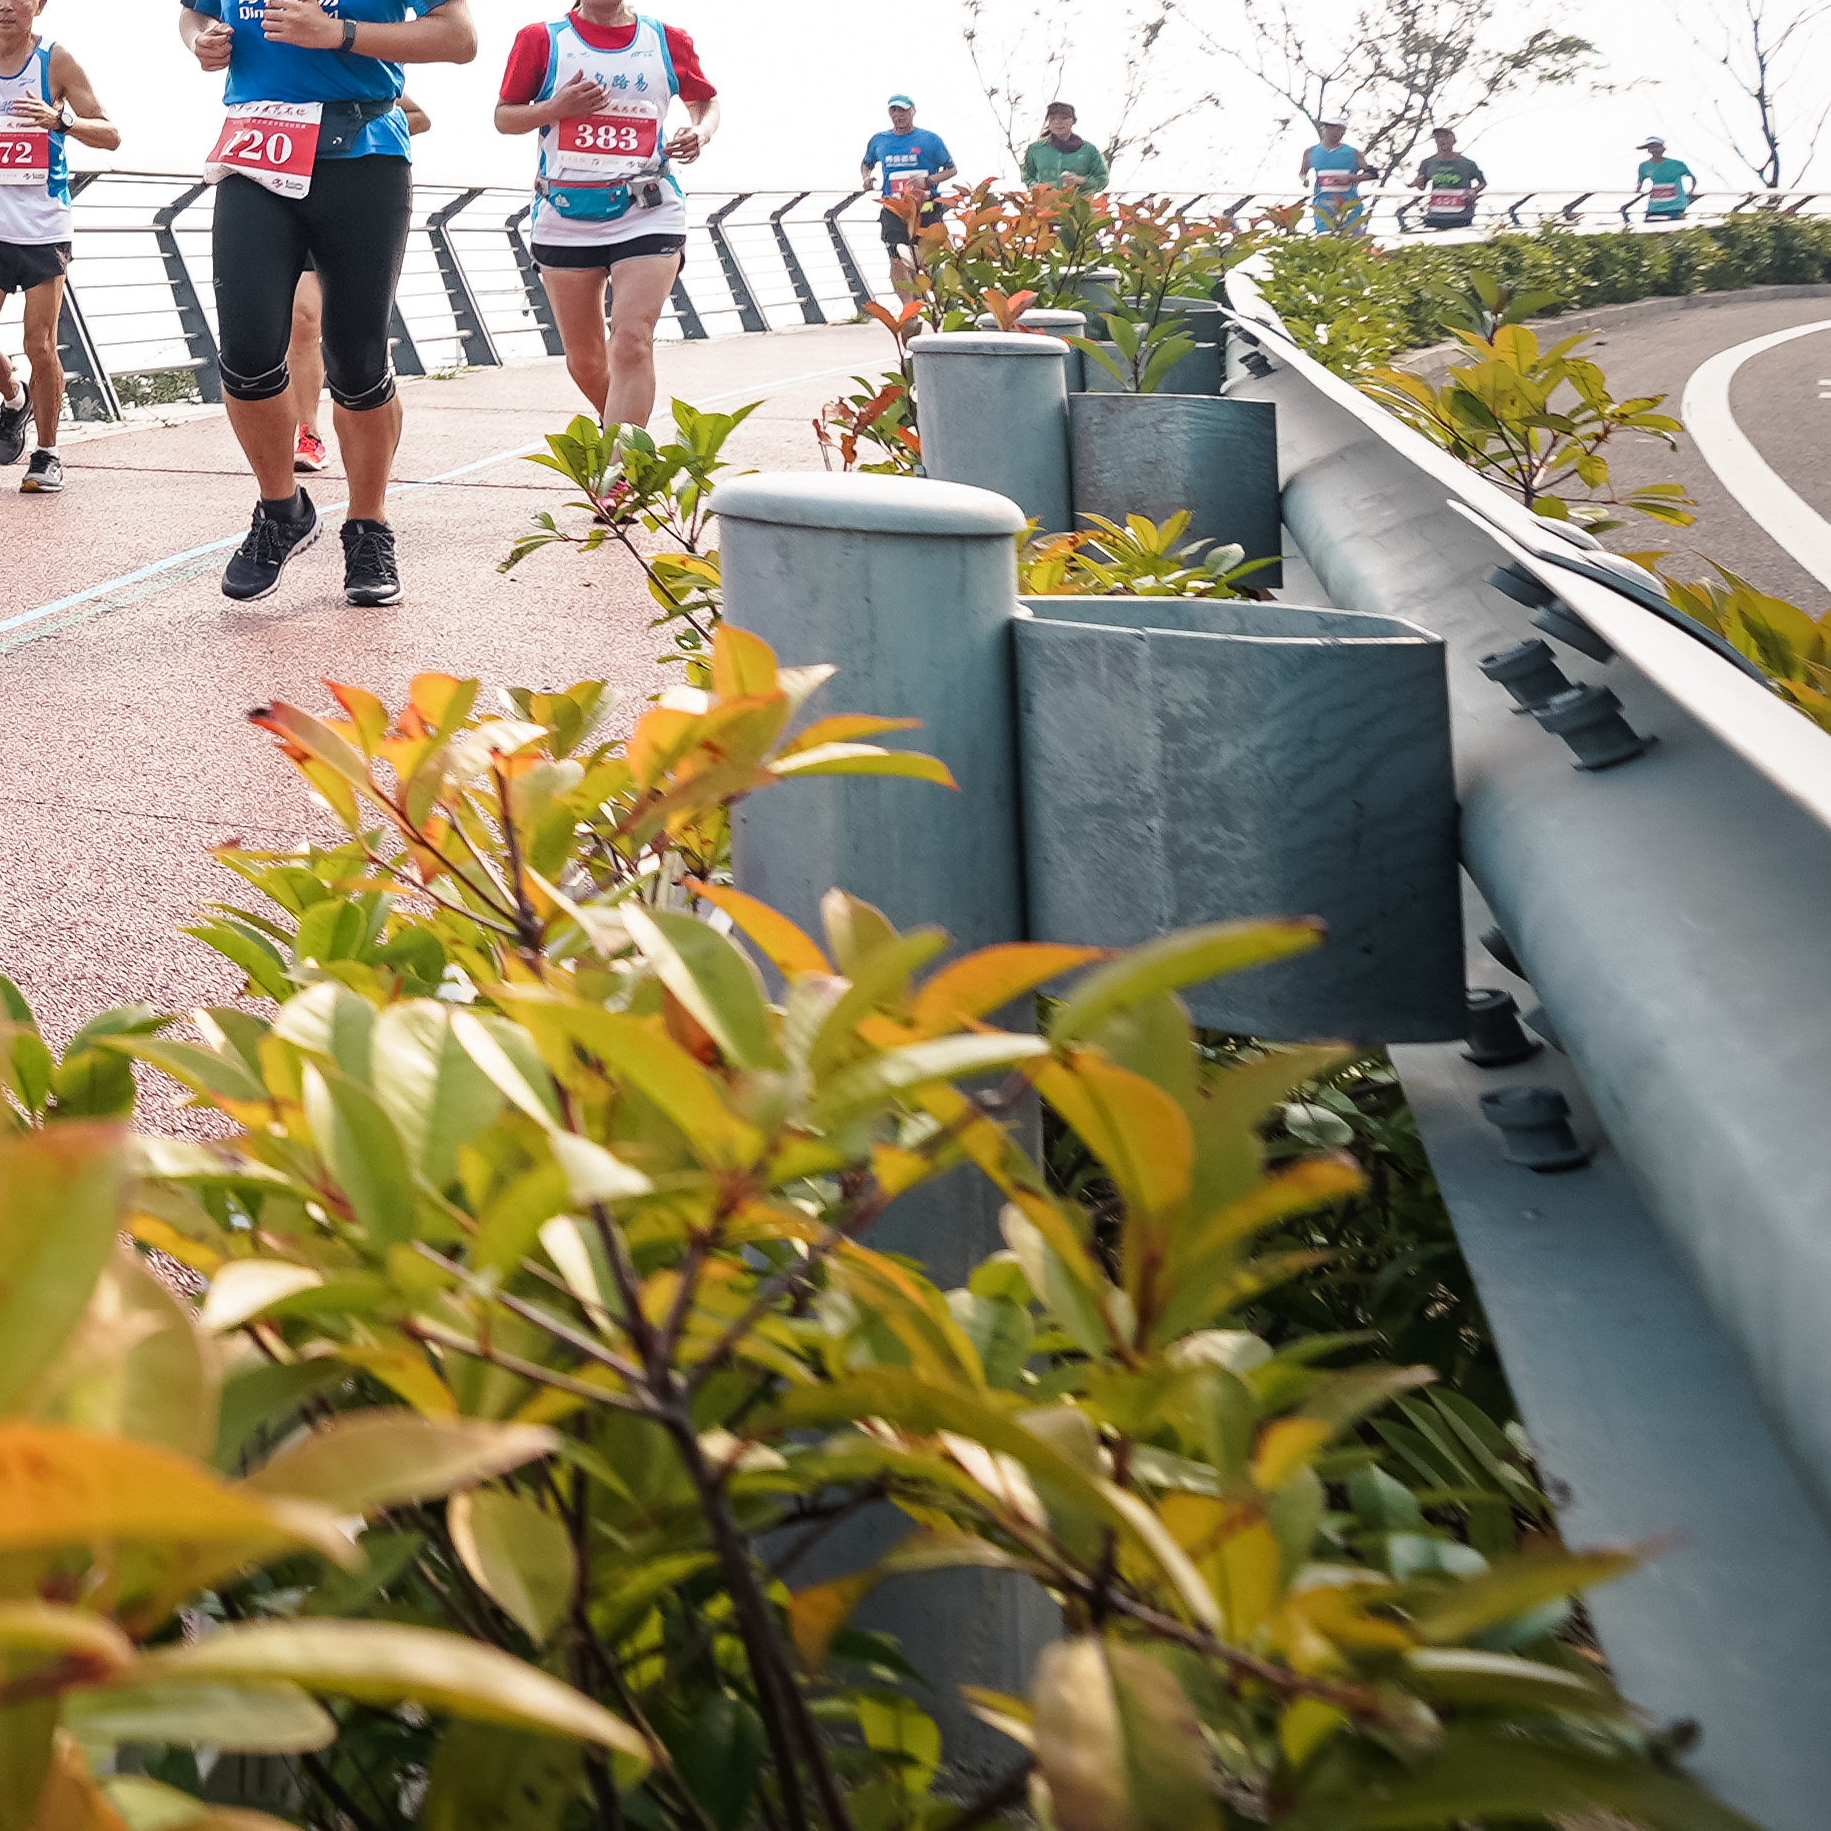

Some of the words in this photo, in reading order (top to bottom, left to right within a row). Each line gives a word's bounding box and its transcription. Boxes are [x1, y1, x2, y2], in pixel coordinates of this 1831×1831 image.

[581, 72, 649, 93] 岛路易
[218, 128, 293, 165] 120
[574, 123, 639, 152] 383
